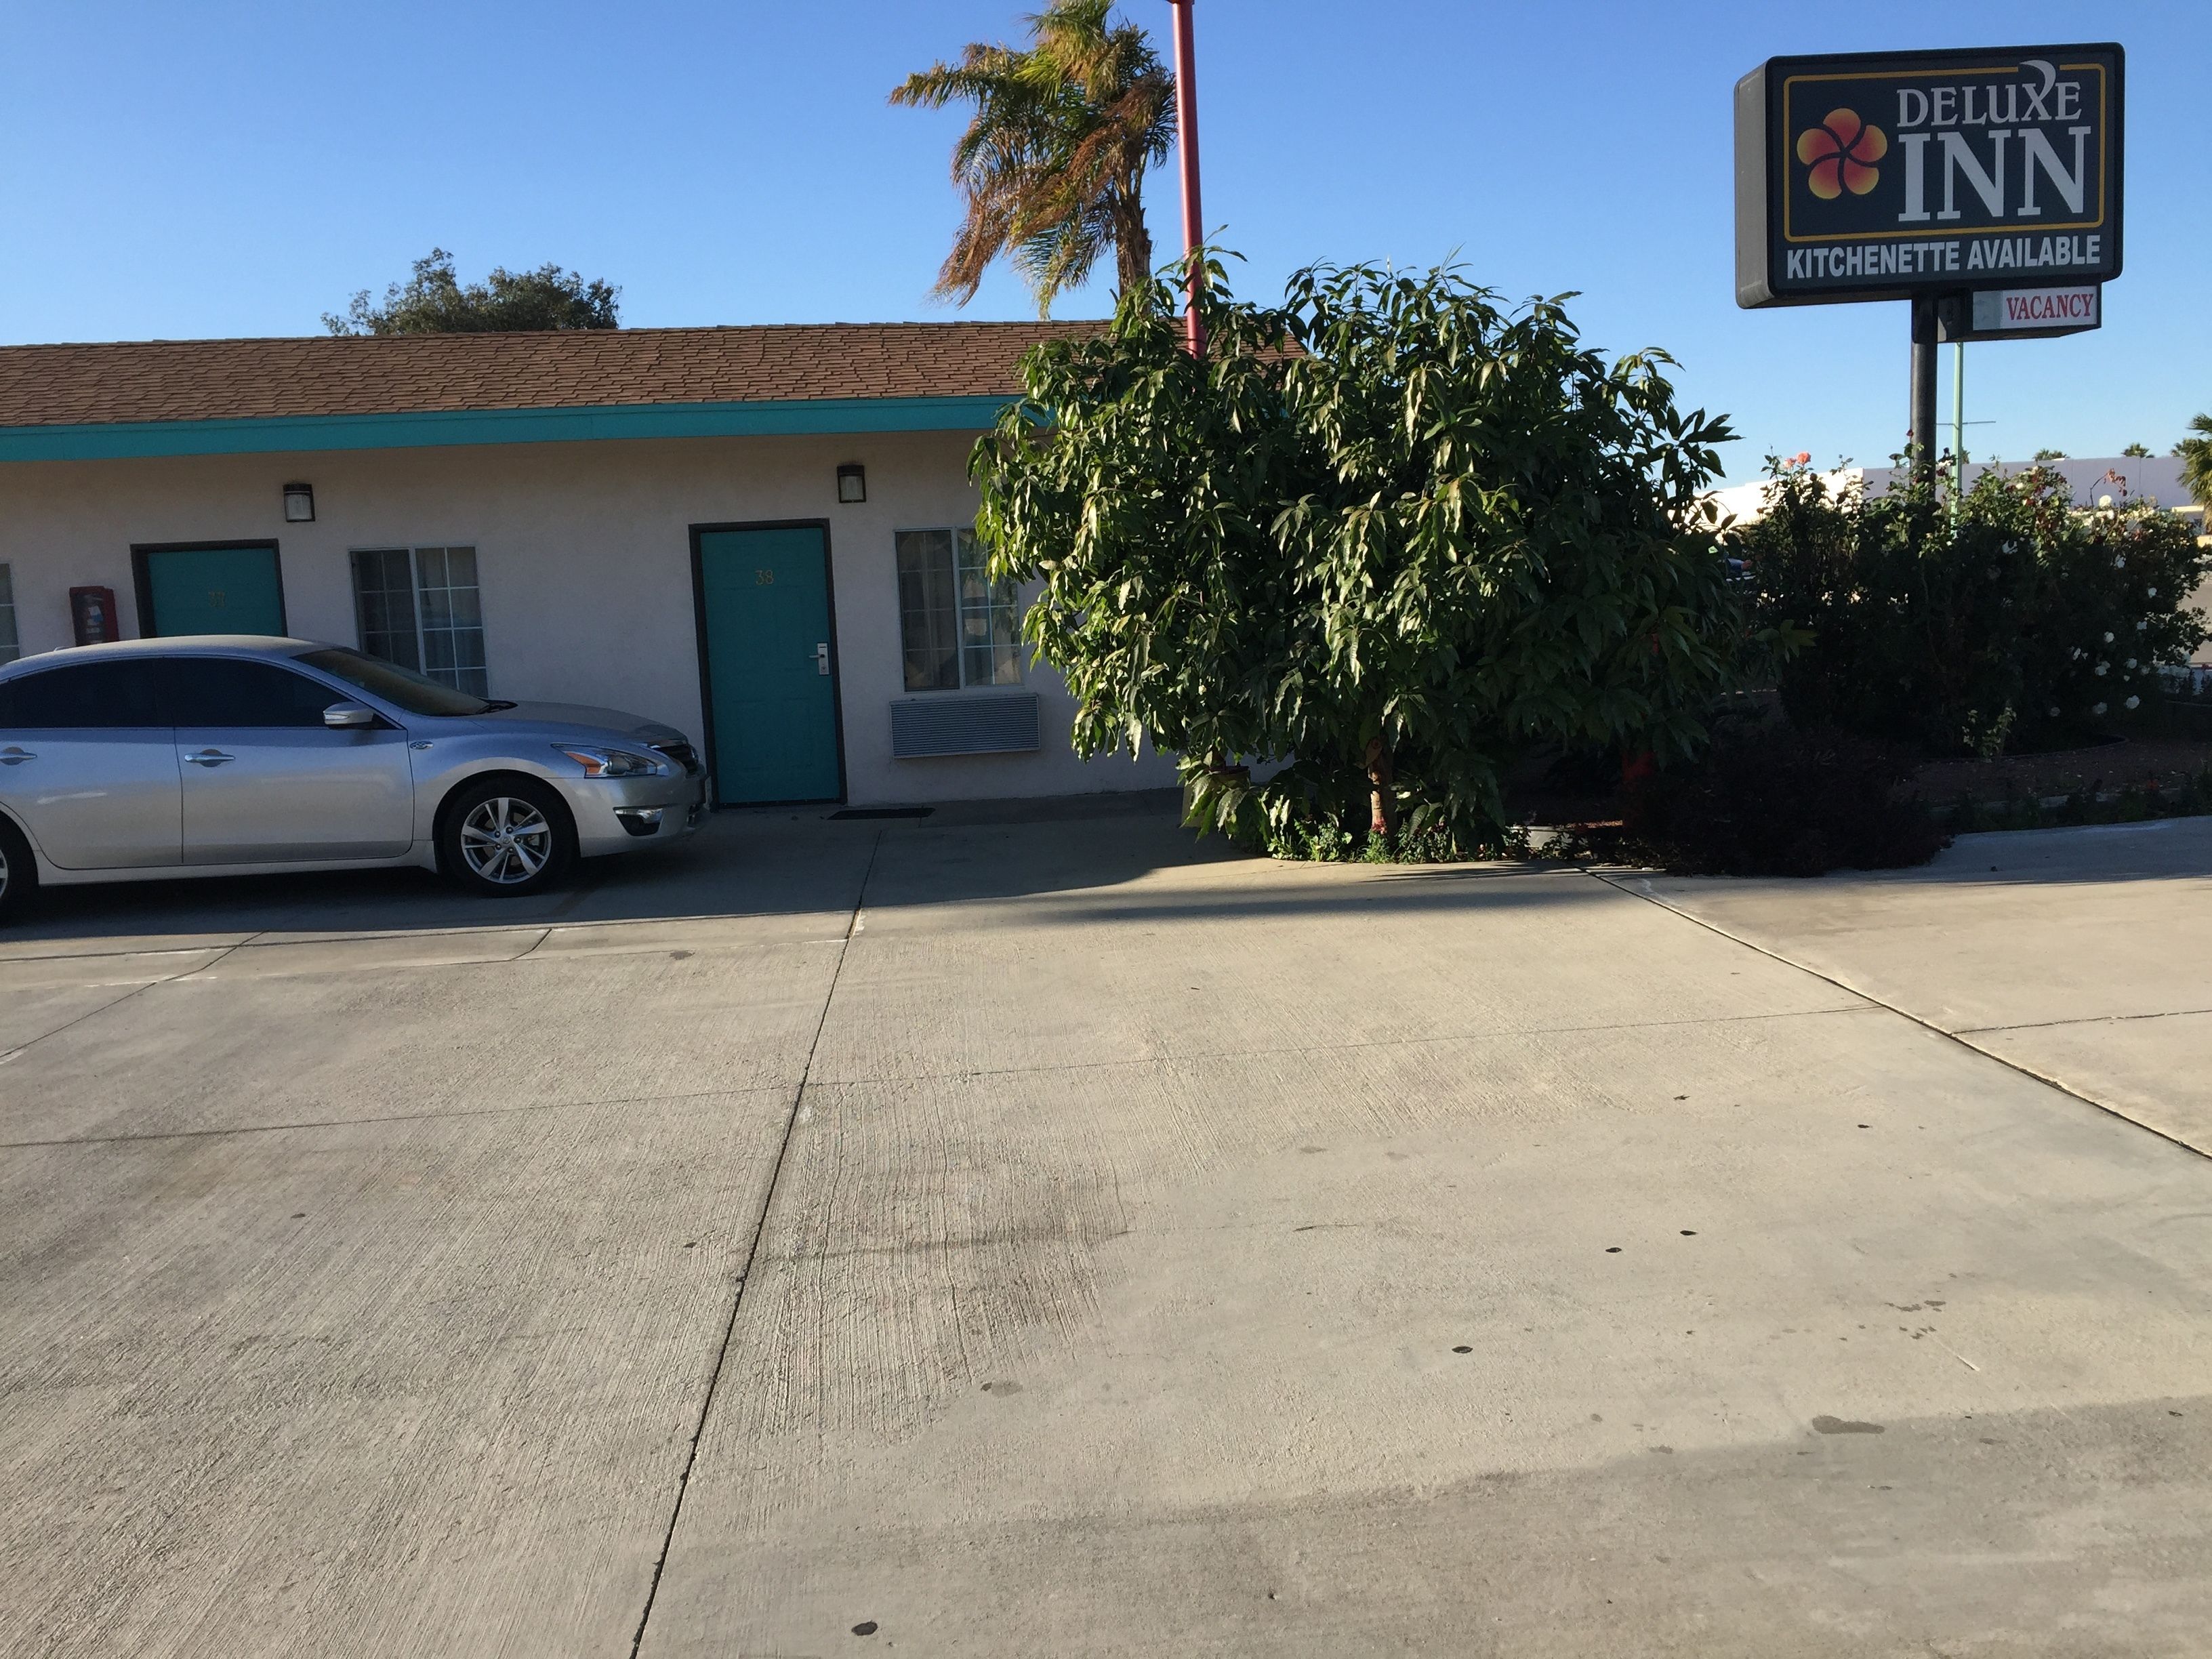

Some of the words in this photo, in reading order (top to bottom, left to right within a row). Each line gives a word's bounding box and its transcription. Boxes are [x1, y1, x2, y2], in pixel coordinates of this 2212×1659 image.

[1897, 60, 2082, 127] DELUXE
[1898, 126, 2091, 222] INN
[1787, 241, 1960, 279] KITCHENETTE
[1967, 234, 2100, 270] AVAILABLE
[2006, 293, 2093, 320] VACANCY
[754, 569, 774, 586] 38
